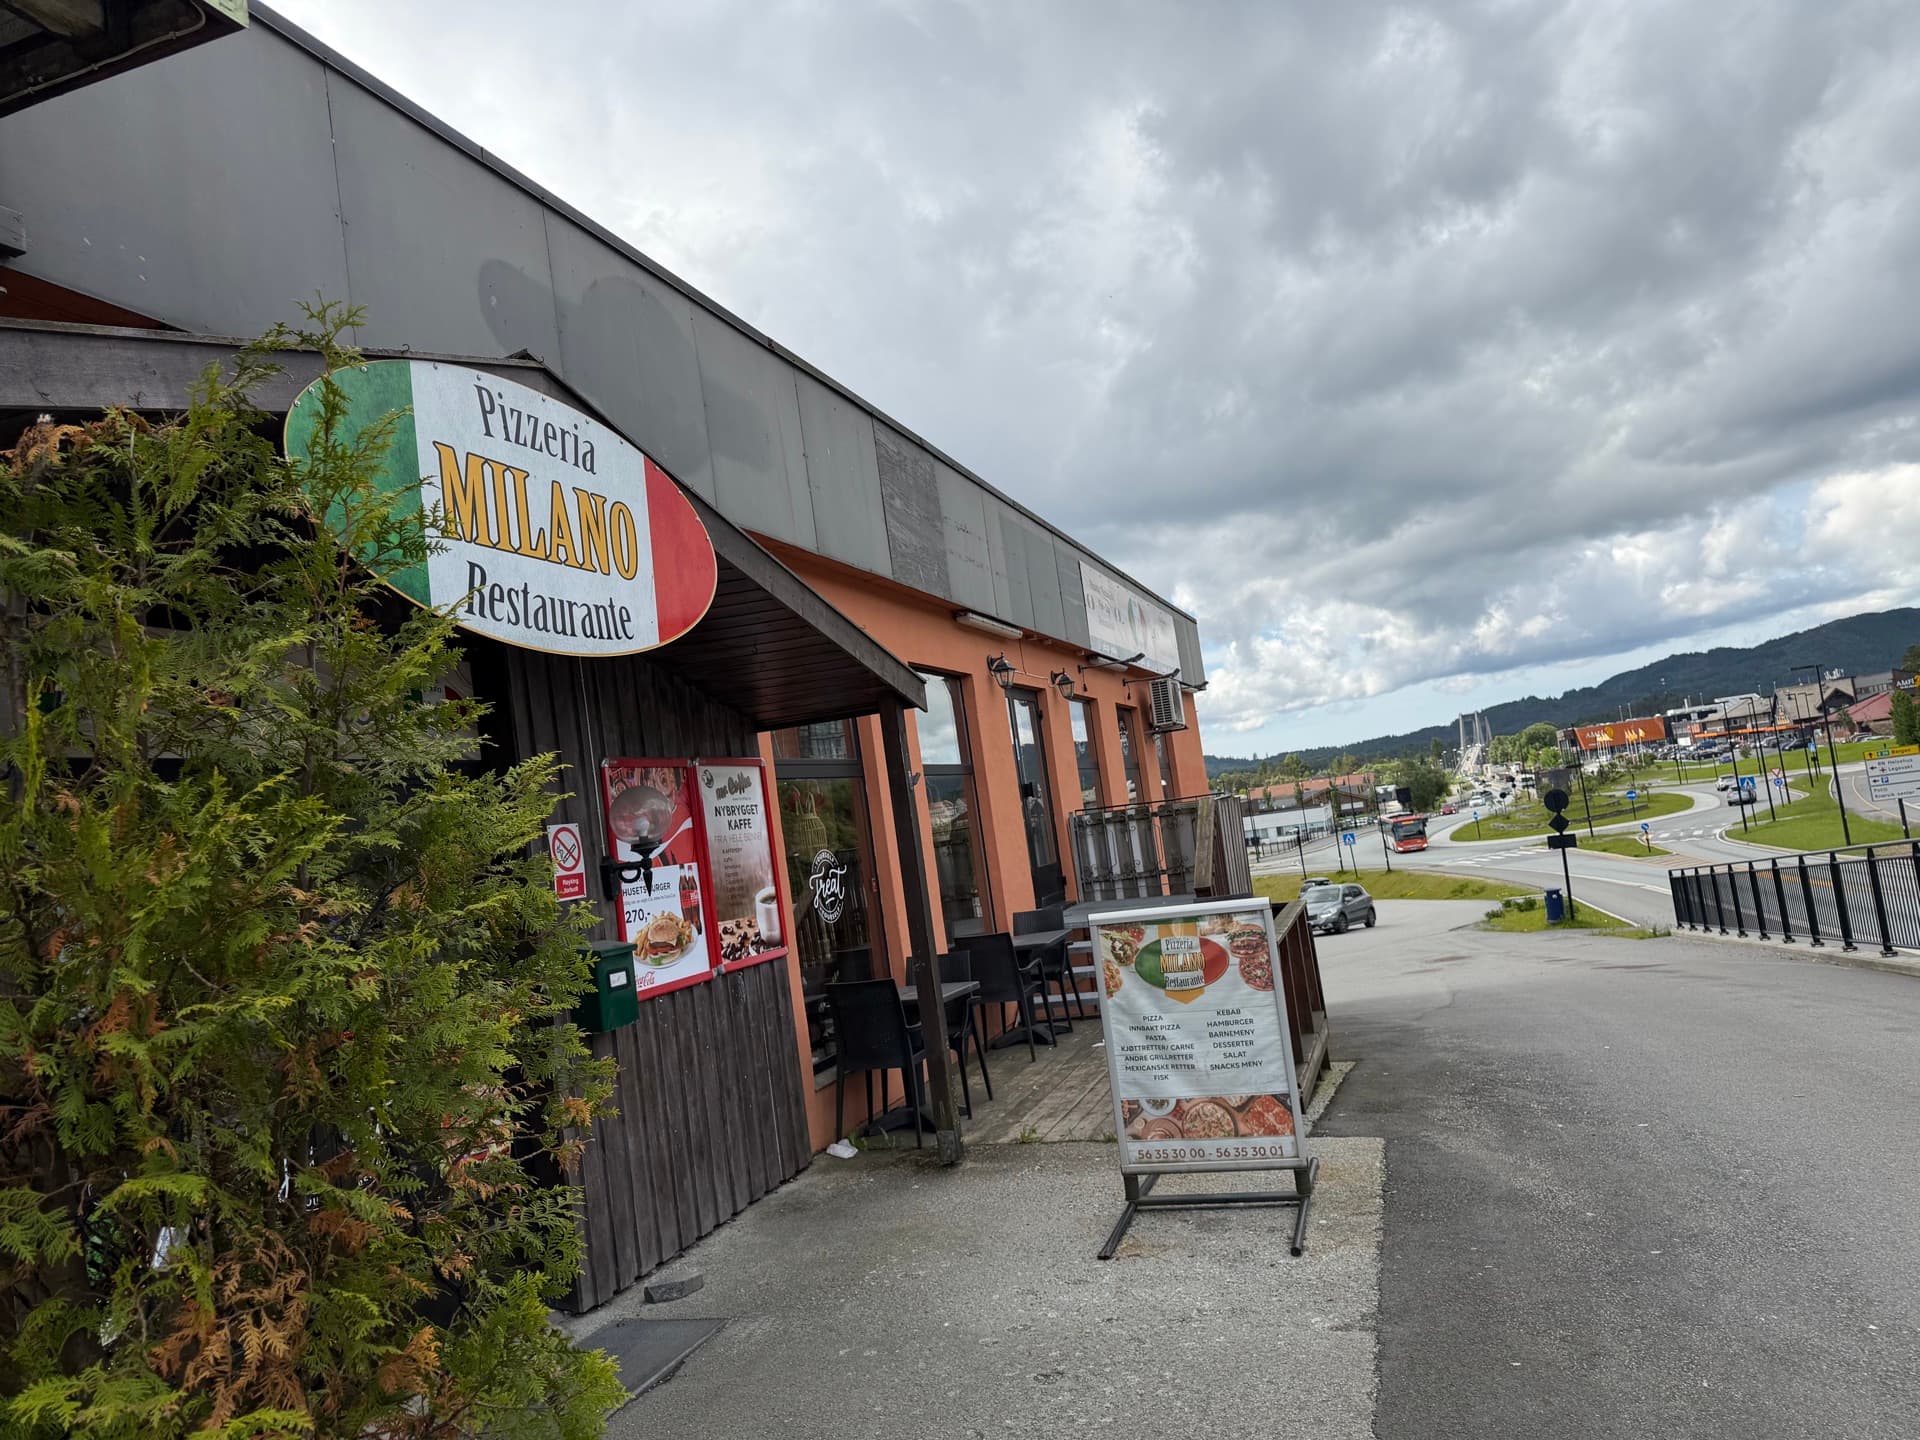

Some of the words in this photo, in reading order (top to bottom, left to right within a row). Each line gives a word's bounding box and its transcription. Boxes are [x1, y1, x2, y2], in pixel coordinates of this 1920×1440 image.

[473, 384, 596, 475] Pizzeria
[432, 440, 638, 581] MILANO
[465, 560, 635, 641] Restaurante
[715, 805, 759, 817] NYBRYGGET
[728, 818, 753, 831] KAFFE
[809, 864, 847, 909] Treat
[1165, 939, 1193, 951] Pizzeria
[1160, 952, 1206, 973] MILANO
[1165, 975, 1204, 988] Restaurante
[1216, 1008, 1241, 1016] KEBAB
[1206, 1018, 1254, 1028] HAMBURGER
[1208, 1029, 1255, 1038] BARNEMENY
[1170, 1043, 1195, 1051] CARNE
[1212, 1040, 1254, 1049] DESSERTER
[1149, 1053, 1194, 1061] GRILLRETTER
[1223, 1051, 1246, 1059] SALAT
[1125, 1063, 1169, 1072] MEXICANSKE
[1210, 1063, 1240, 1071] SNACKS
[1241, 1060, 1263, 1068] MENY
[1138, 1149, 1152, 1159] 56
[1155, 1148, 1169, 1159] 35
[1173, 1148, 1187, 1159] 30
[1190, 1147, 1206, 1158] 00
[1216, 1147, 1231, 1157] 56
[1234, 1147, 1248, 1157] 35
[1251, 1146, 1266, 1157] 30
[1270, 1145, 1284, 1156] 01
